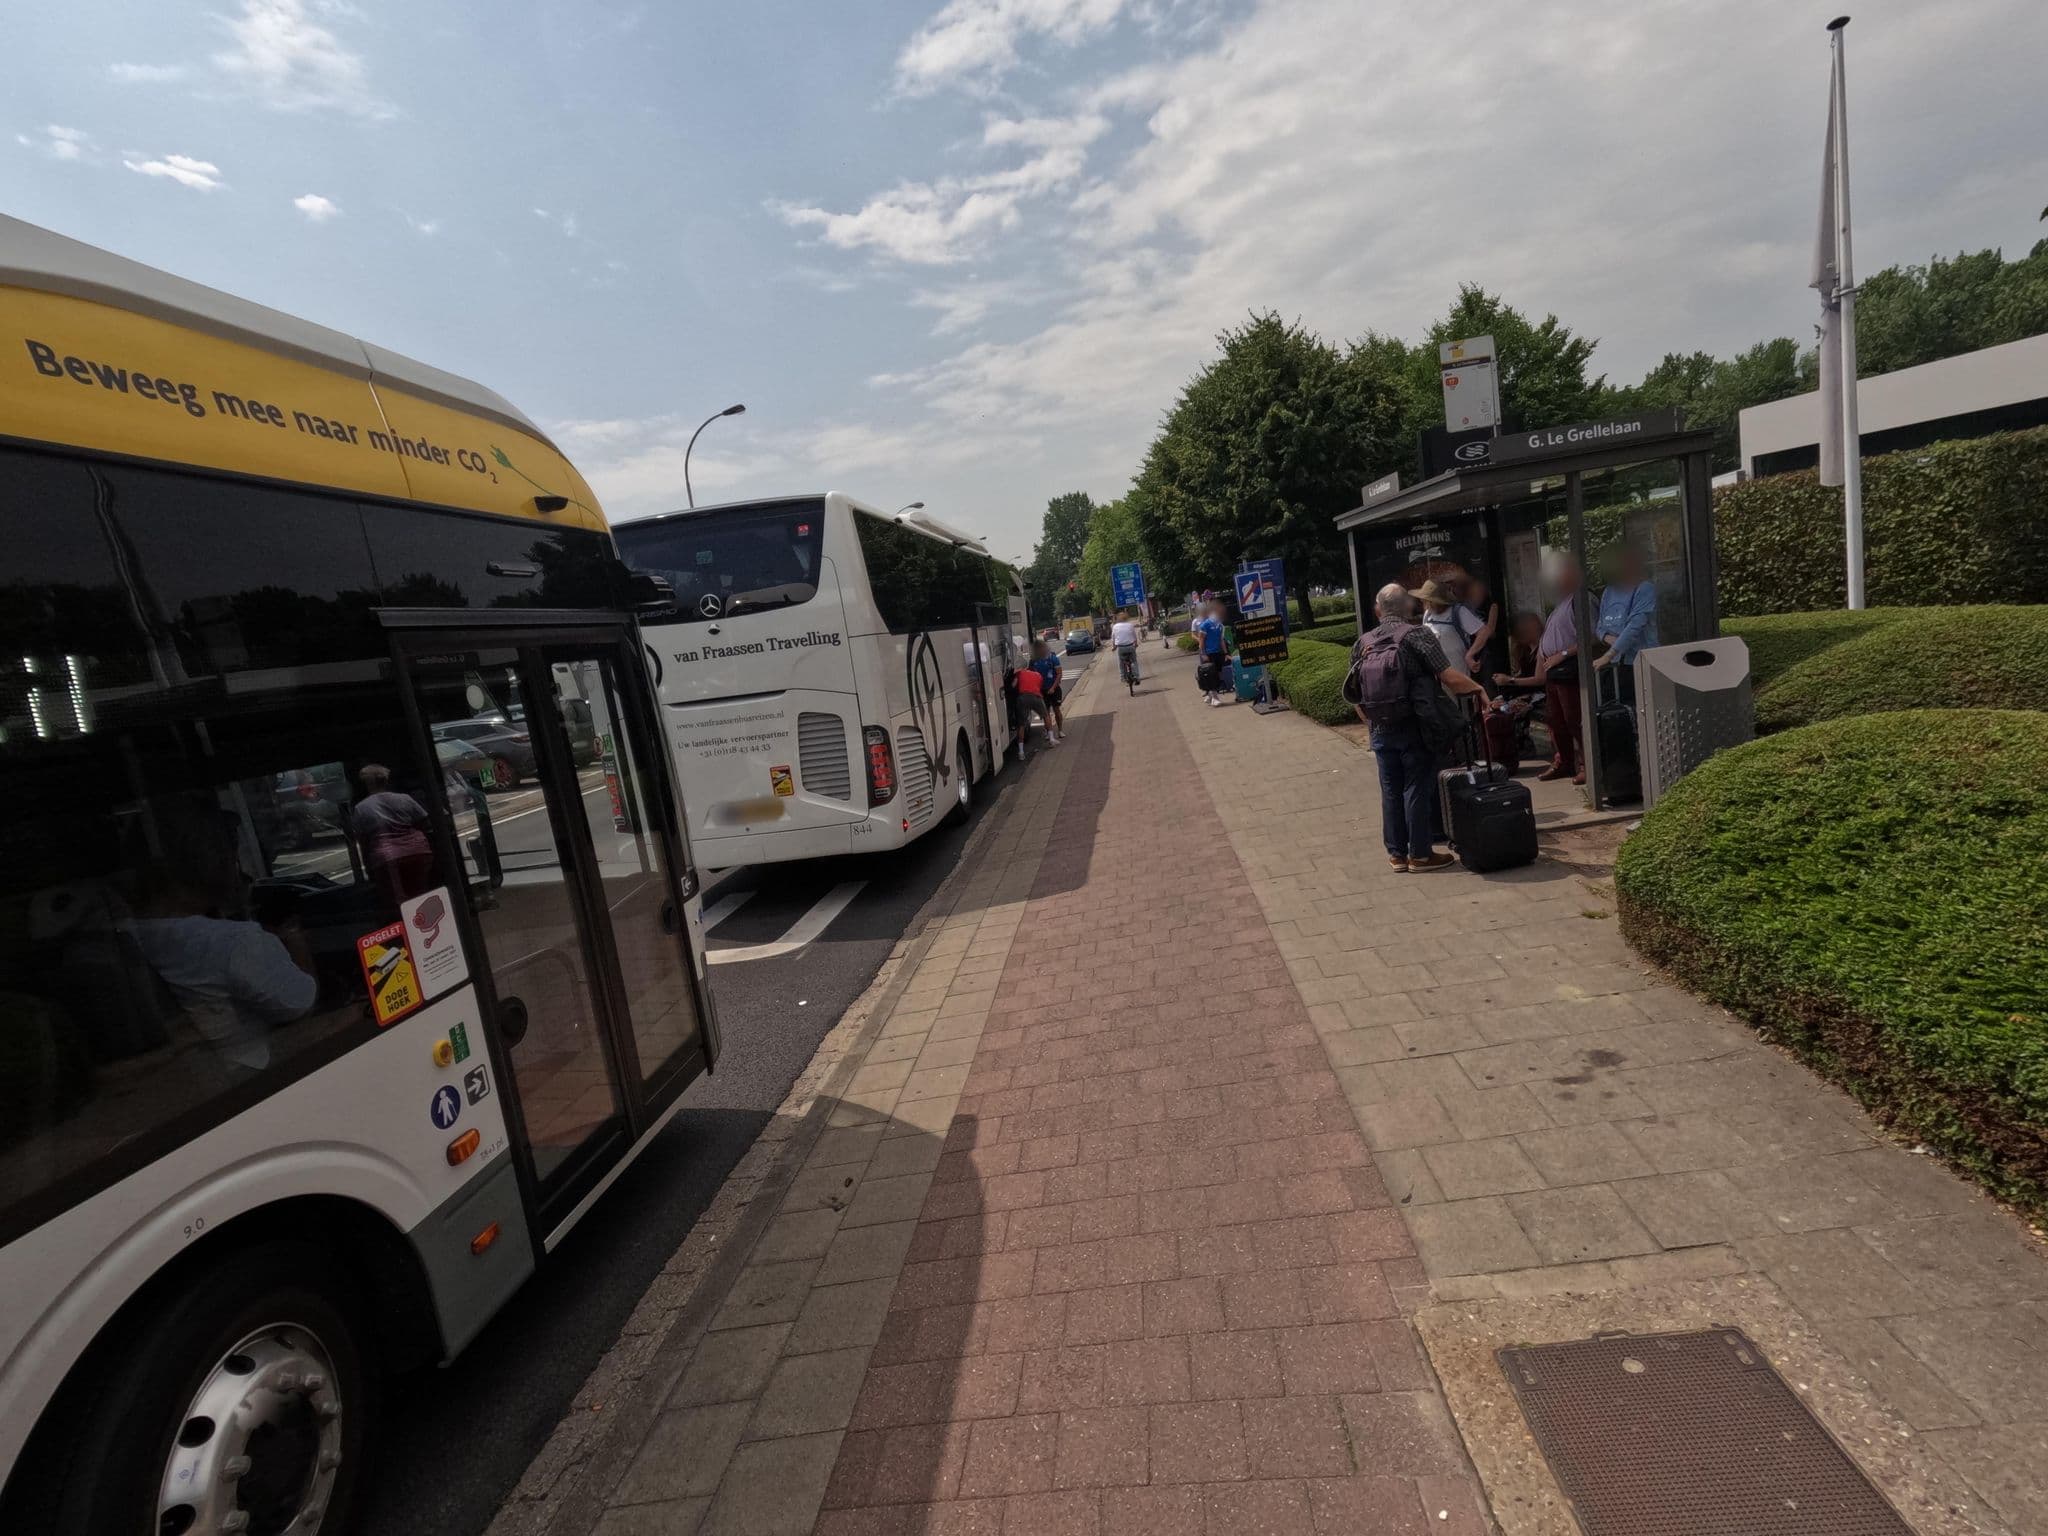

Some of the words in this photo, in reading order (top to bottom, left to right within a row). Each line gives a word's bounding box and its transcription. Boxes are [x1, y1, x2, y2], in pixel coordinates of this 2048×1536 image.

[24, 338, 206, 418] Beweeg
[211, 390, 286, 428] mee
[292, 409, 358, 445] naar
[367, 428, 450, 466] minder
[1528, 435, 1544, 448] G.
[1548, 432, 1564, 445] Le
[1567, 421, 1641, 442] Grellelaan
[673, 651, 699, 663] van
[702, 642, 764, 660] Fraassen
[766, 631, 841, 651] Travelling
[361, 924, 401, 948] OPGELET
[385, 985, 409, 1005] DODE
[387, 995, 411, 1014] HOEK
